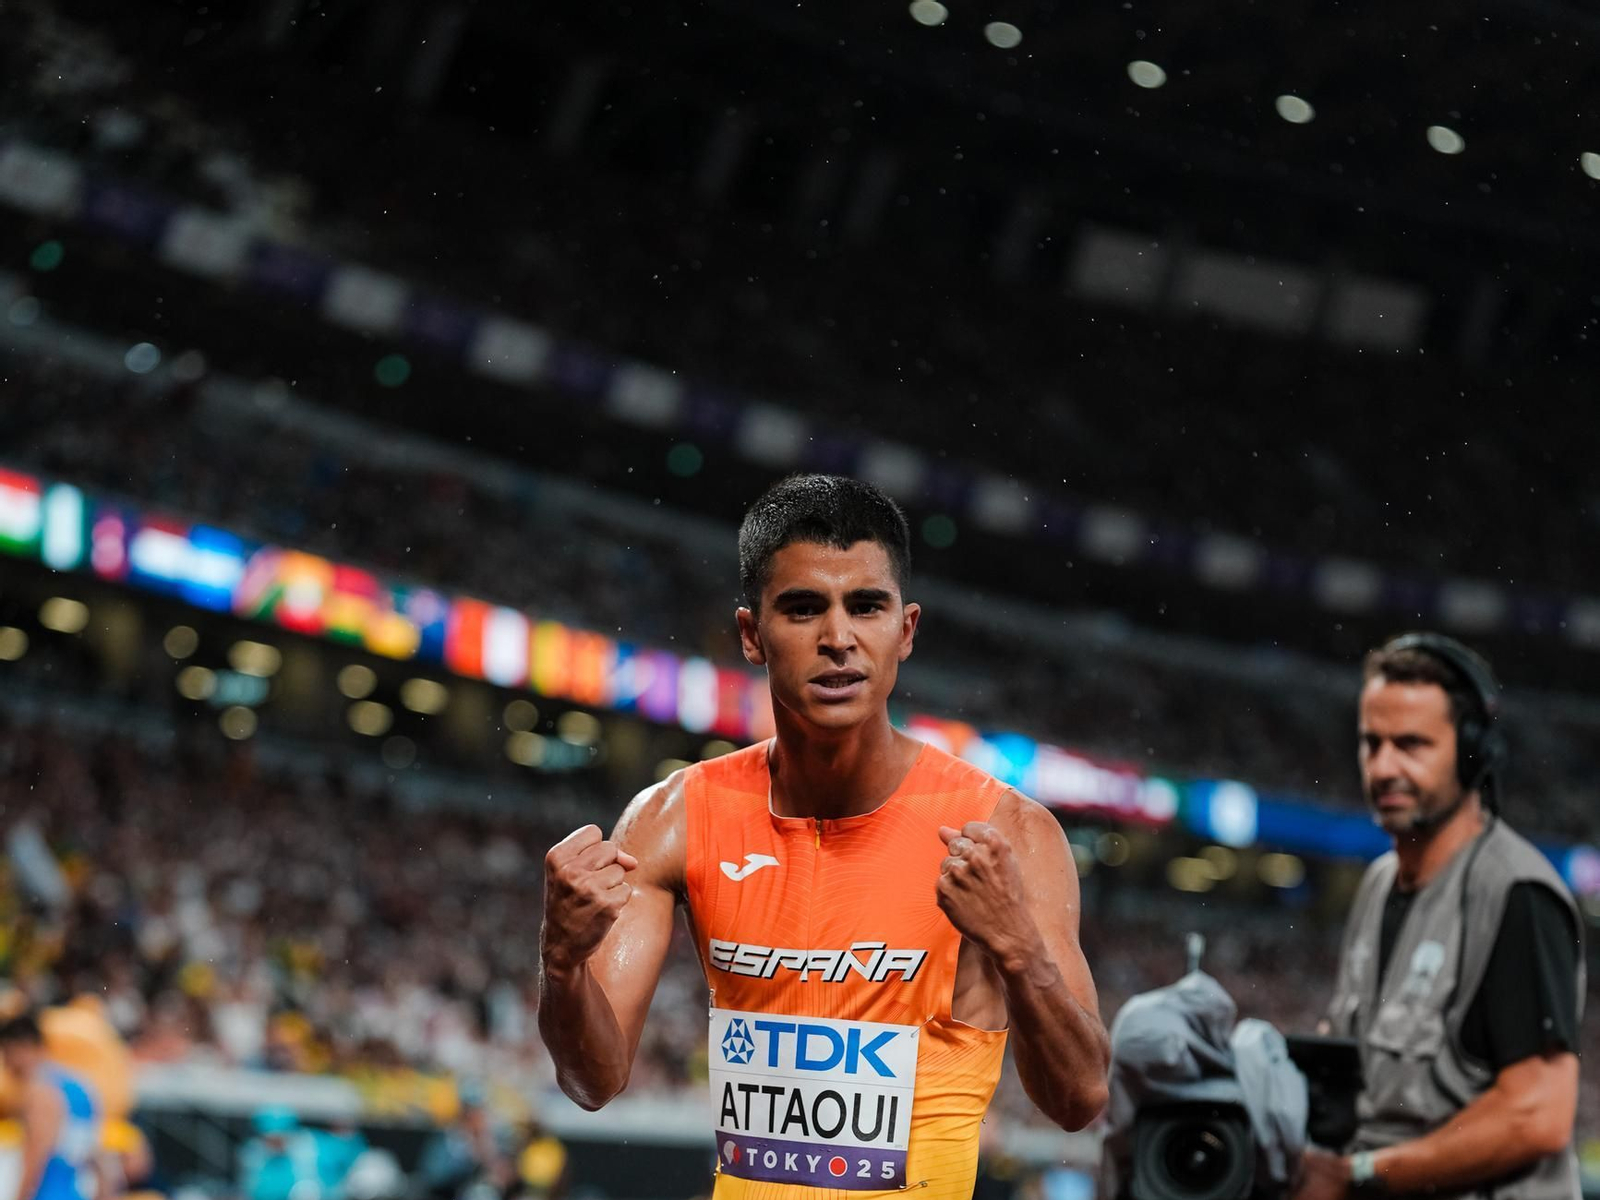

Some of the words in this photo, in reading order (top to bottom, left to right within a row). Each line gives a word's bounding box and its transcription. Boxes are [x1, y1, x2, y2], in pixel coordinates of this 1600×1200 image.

[709, 938, 928, 982] ESPAÑA
[754, 1019, 900, 1079] TDK
[720, 1081, 899, 1143] ATTAOUI
[856, 1159, 896, 1180] 25
